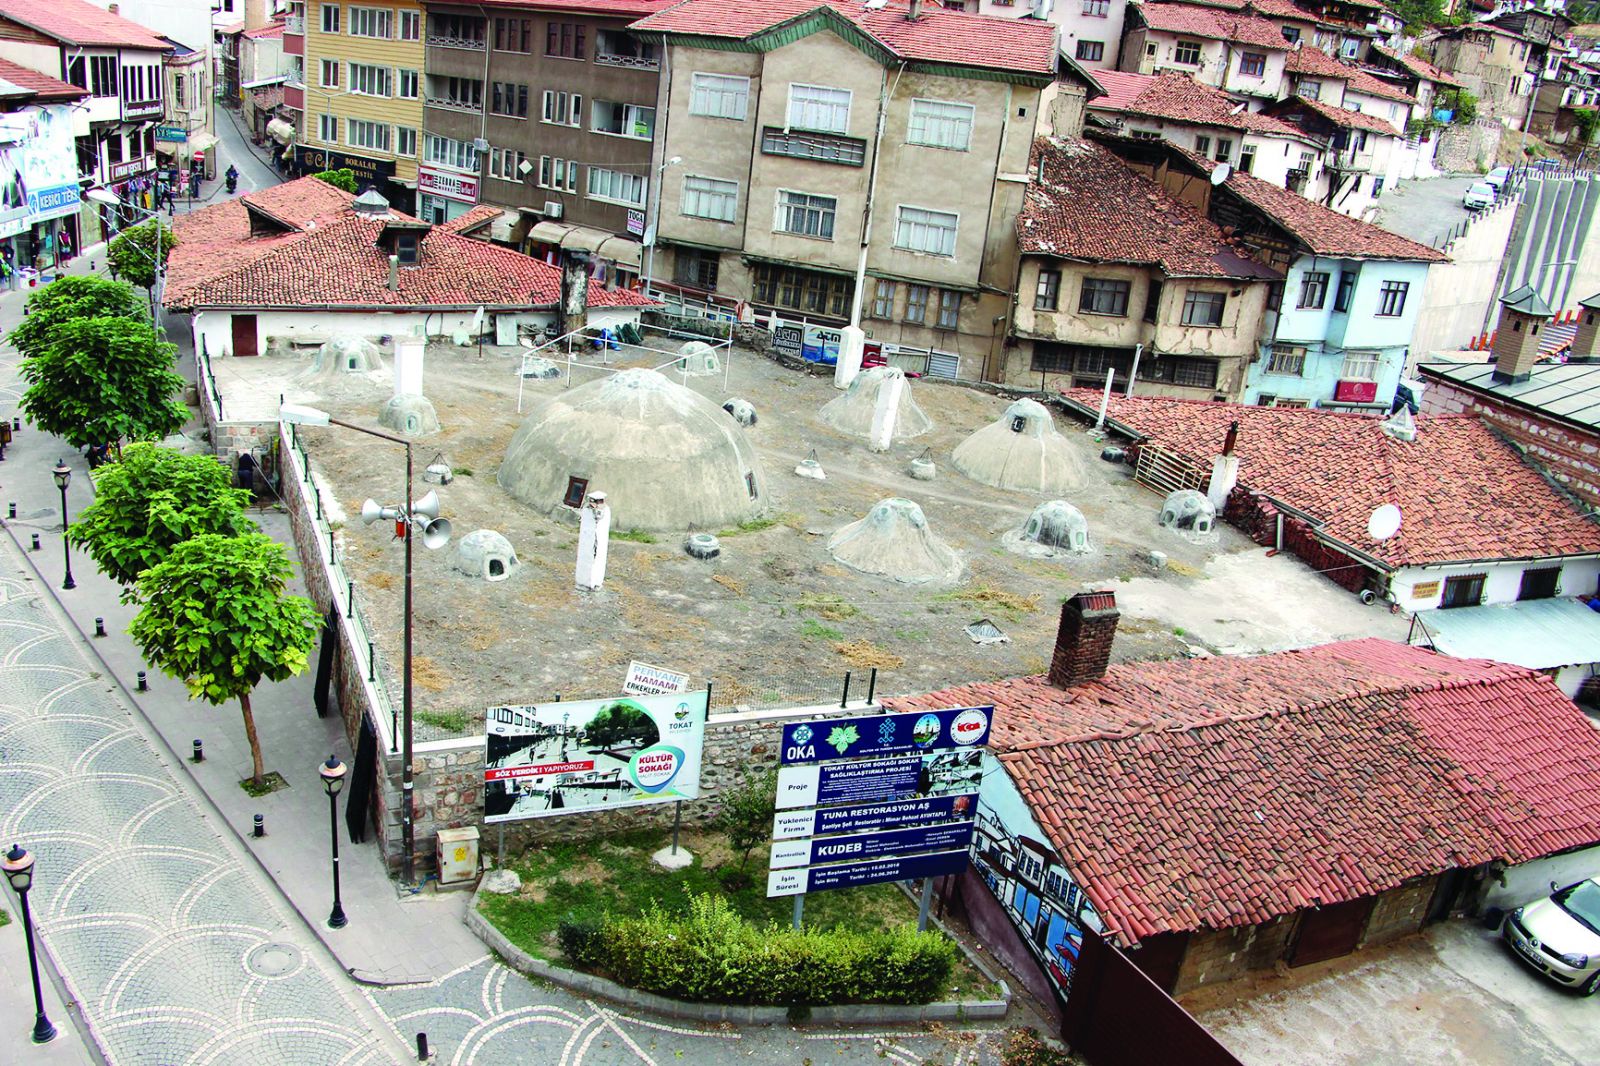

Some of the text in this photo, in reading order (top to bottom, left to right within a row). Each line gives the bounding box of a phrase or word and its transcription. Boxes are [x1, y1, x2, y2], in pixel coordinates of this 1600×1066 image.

[345, 158, 377, 170] BORALAR
[438, 176, 456, 187] ZEBRA
[634, 666, 684, 684] PERVANE
[627, 682, 660, 694] ERKEKLER
[634, 674, 678, 691] HAMAMI
[787, 745, 815, 760] OKA
[639, 753, 673, 764] KÜLTÜR
[512, 768, 538, 776] VERDİK
[638, 763, 672, 773] SOKAĞI
[830, 769, 884, 778] SAĞLIKLAŞTIRMA
[823, 811, 848, 820] TUNA
[851, 804, 916, 815] RESTORASYON
[778, 816, 812, 825] Yüklenici
[822, 822, 841, 830] Şantiye
[818, 843, 862, 856] KUDEB
